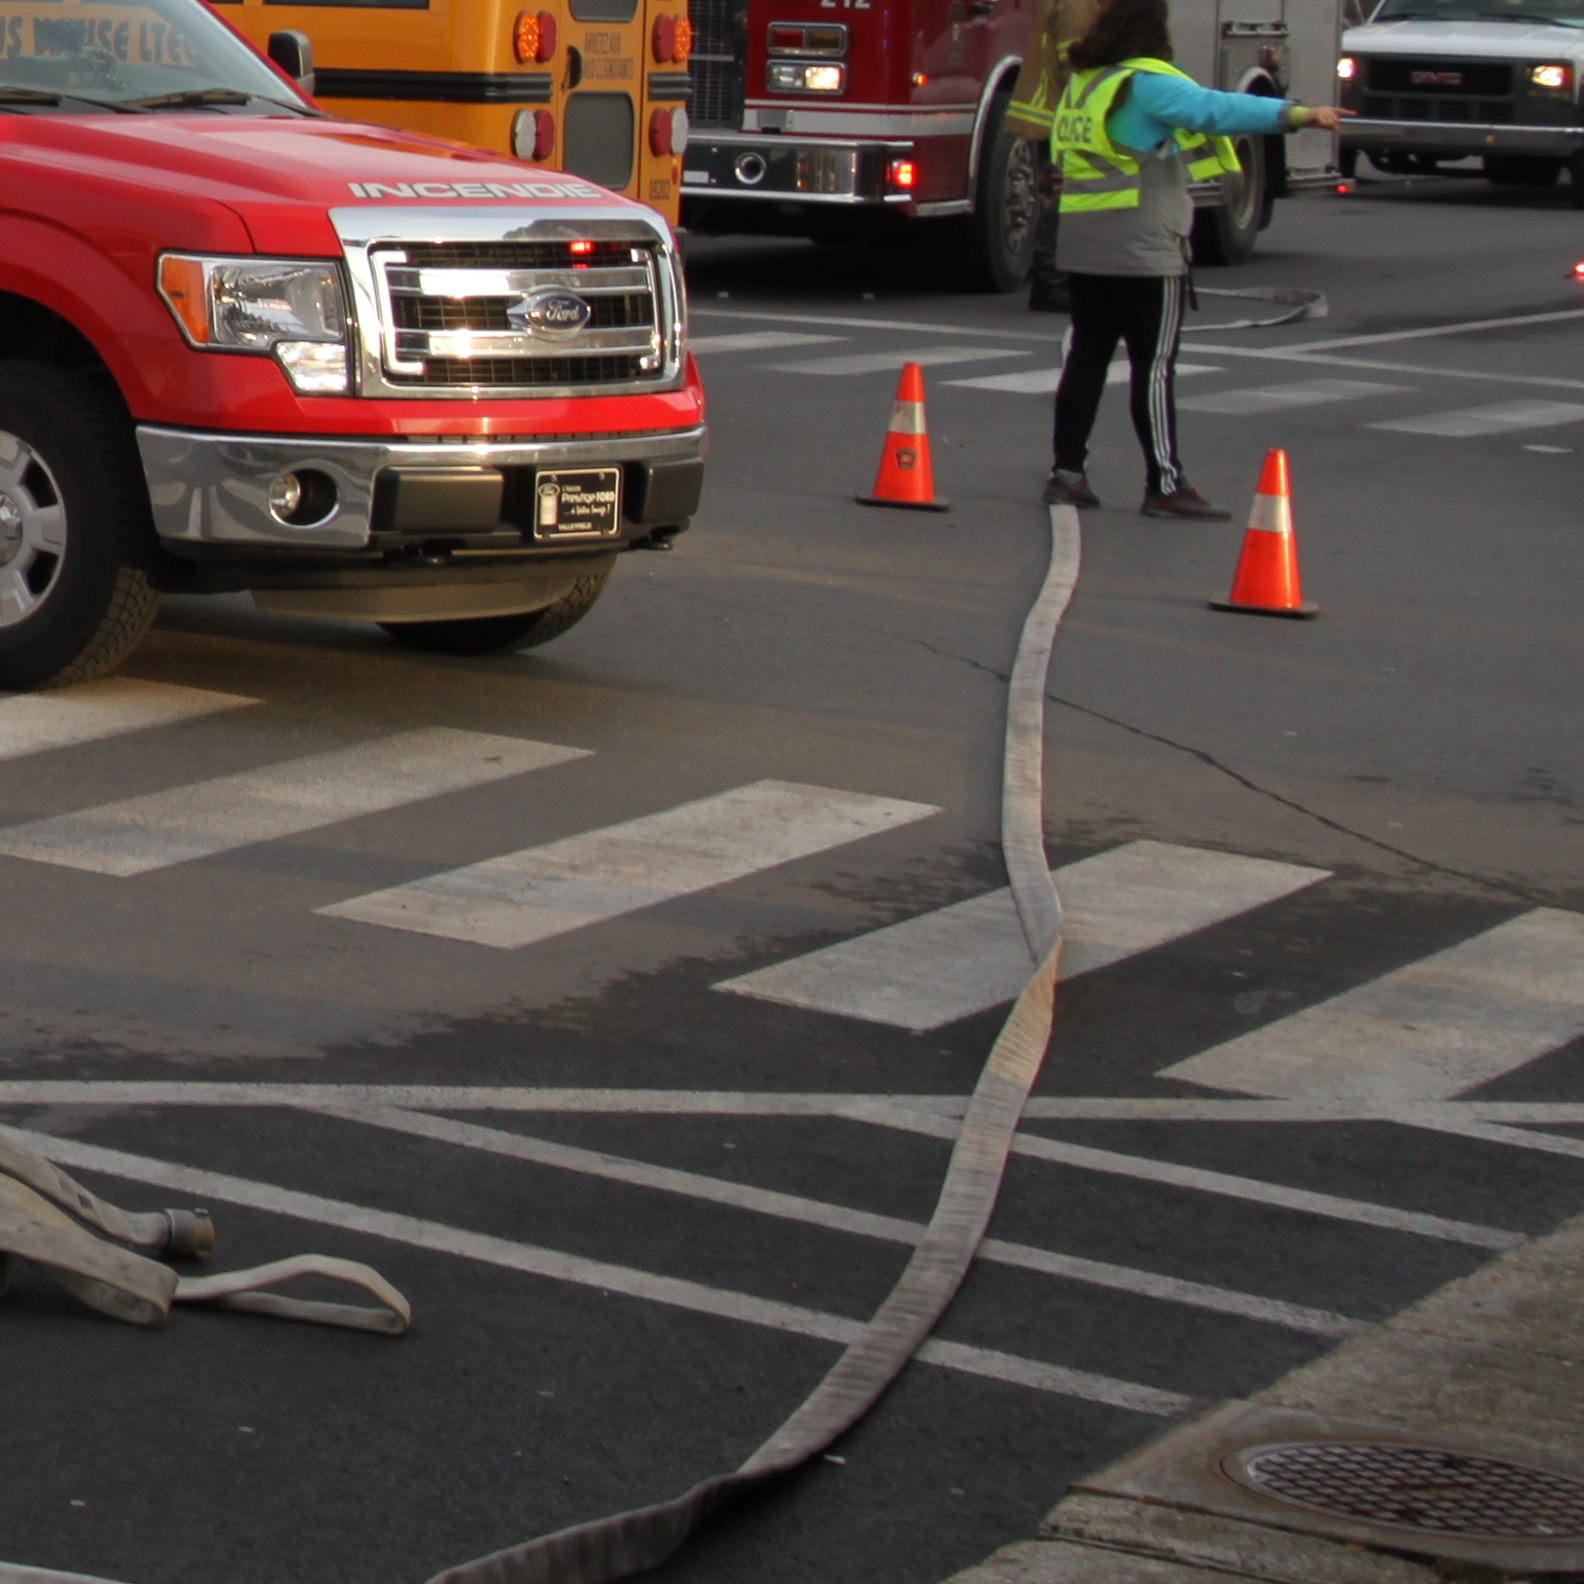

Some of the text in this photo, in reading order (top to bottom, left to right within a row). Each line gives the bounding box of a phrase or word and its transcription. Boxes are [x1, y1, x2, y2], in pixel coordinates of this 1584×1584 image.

[1056, 118, 1093, 144] OLICE
[347, 182, 602, 199] INCENDIE
[546, 299, 580, 322] Ford
